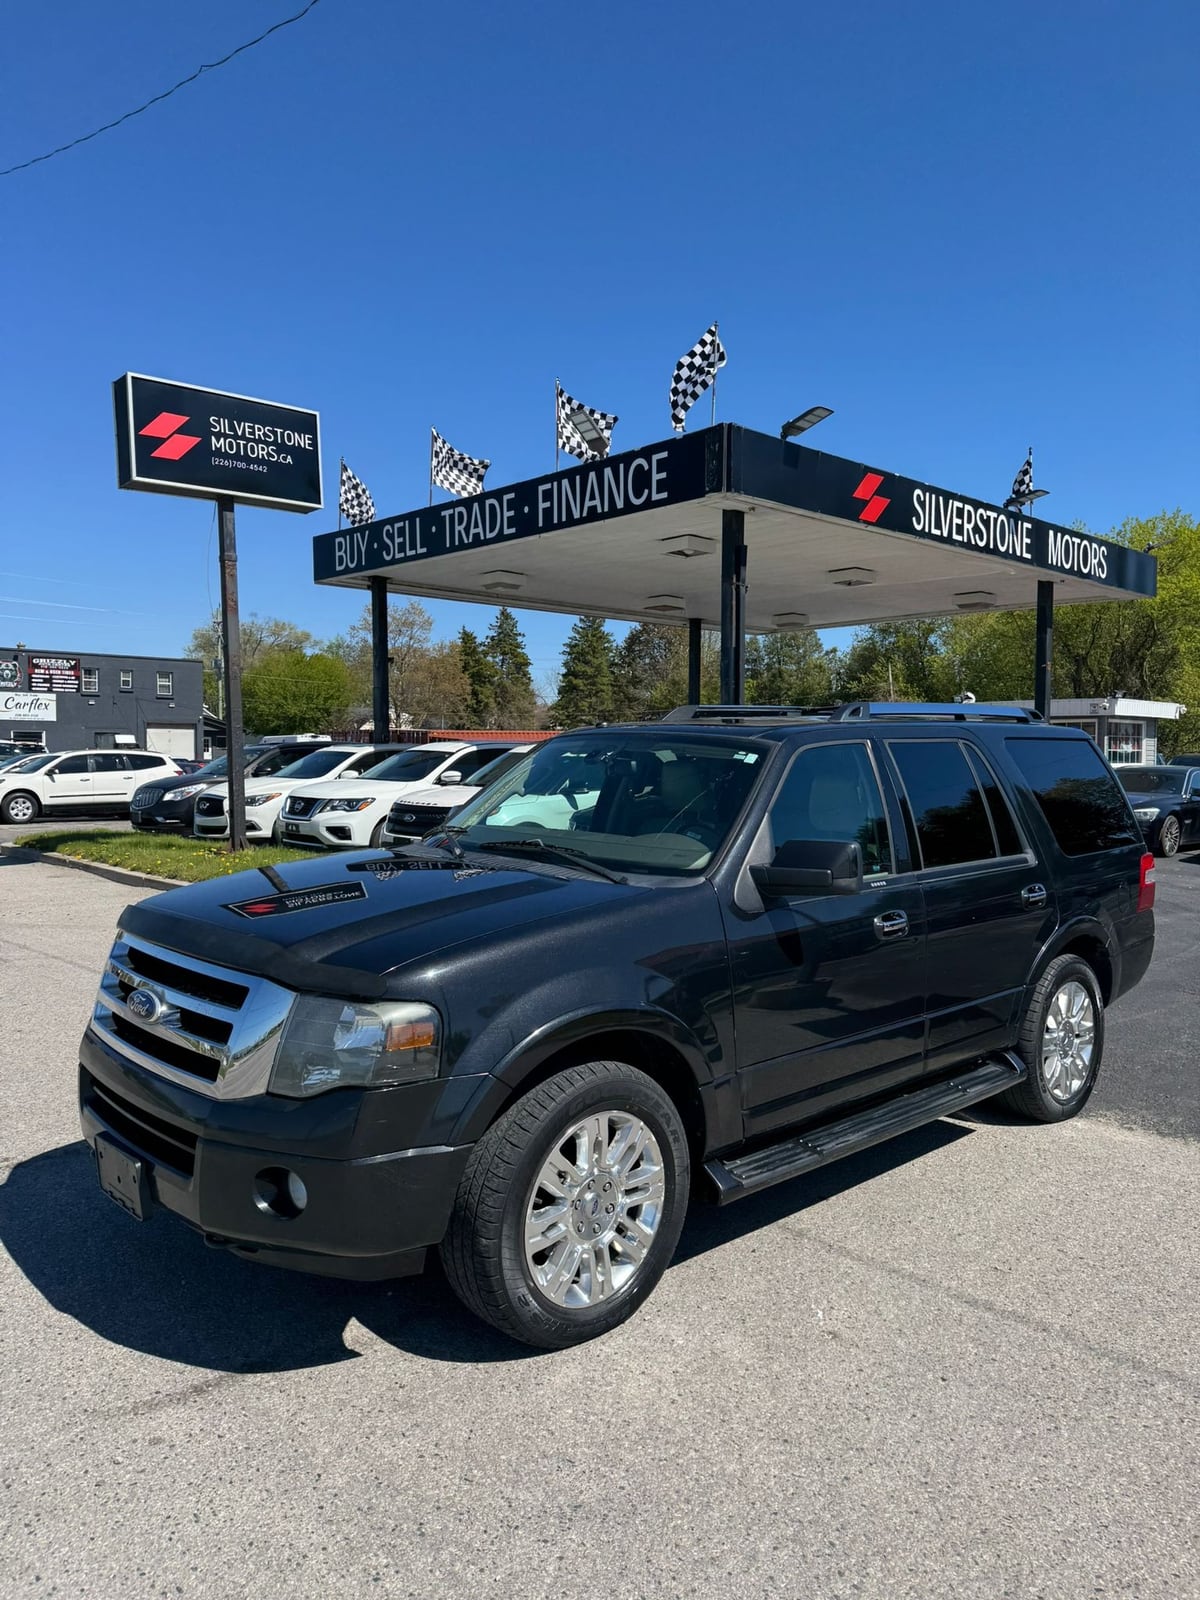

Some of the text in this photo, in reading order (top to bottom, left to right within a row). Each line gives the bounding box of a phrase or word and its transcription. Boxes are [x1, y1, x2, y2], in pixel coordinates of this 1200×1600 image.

[209, 416, 314, 450] SILVERSTONE
[211, 436, 293, 465] MOTORS.CA
[211, 456, 268, 473] (226)700-4542
[335, 451, 669, 571] BUY SELL TRADE FINANCE
[912, 488, 1108, 579] SILVERSTONE MOTORS
[32, 658, 76, 666] GRIZZLY
[4, 696, 50, 713] Carflex
[130, 993, 150, 1016] Ford
